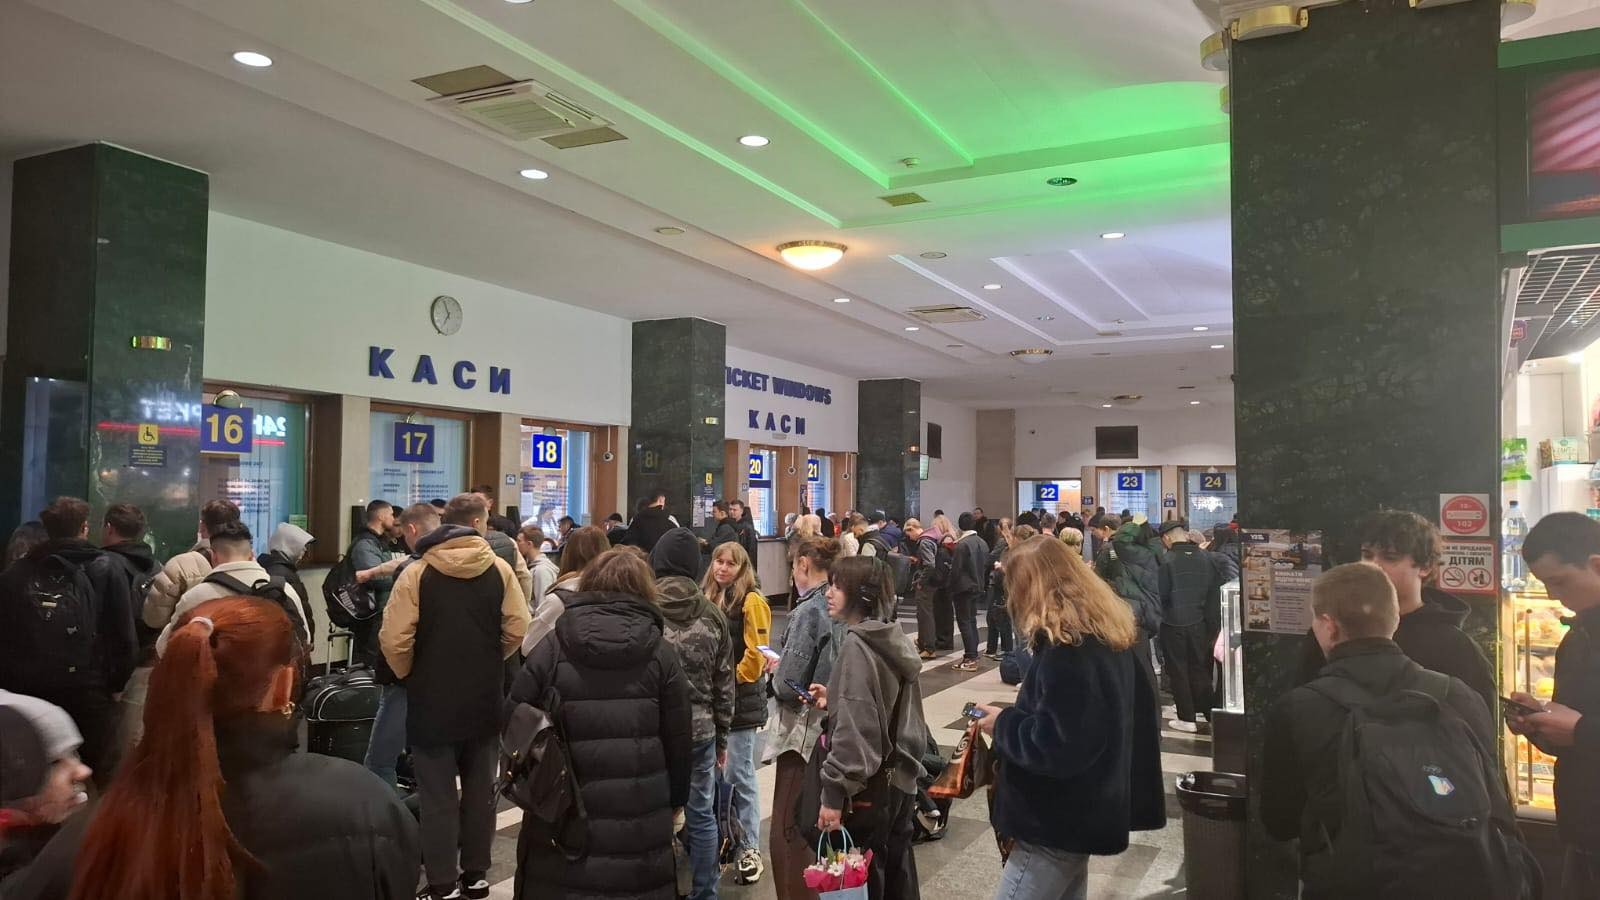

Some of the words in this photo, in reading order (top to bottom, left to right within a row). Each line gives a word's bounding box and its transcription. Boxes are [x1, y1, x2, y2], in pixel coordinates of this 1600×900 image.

[369, 346, 511, 395] КАСИ
[725, 367, 769, 392] ICKET
[772, 376, 832, 405] WINDOWS
[206, 413, 244, 445] 16
[748, 410, 806, 435] КАСИ
[402, 431, 428, 456] 17
[536, 441, 557, 464] 18
[749, 459, 761, 475] 20
[808, 463, 817, 478] 21
[1122, 477, 1138, 488] 23
[1205, 477, 1222, 488] 24
[1040, 487, 1055, 498] 22
[1449, 556, 1485, 566] ДІТЯМ
